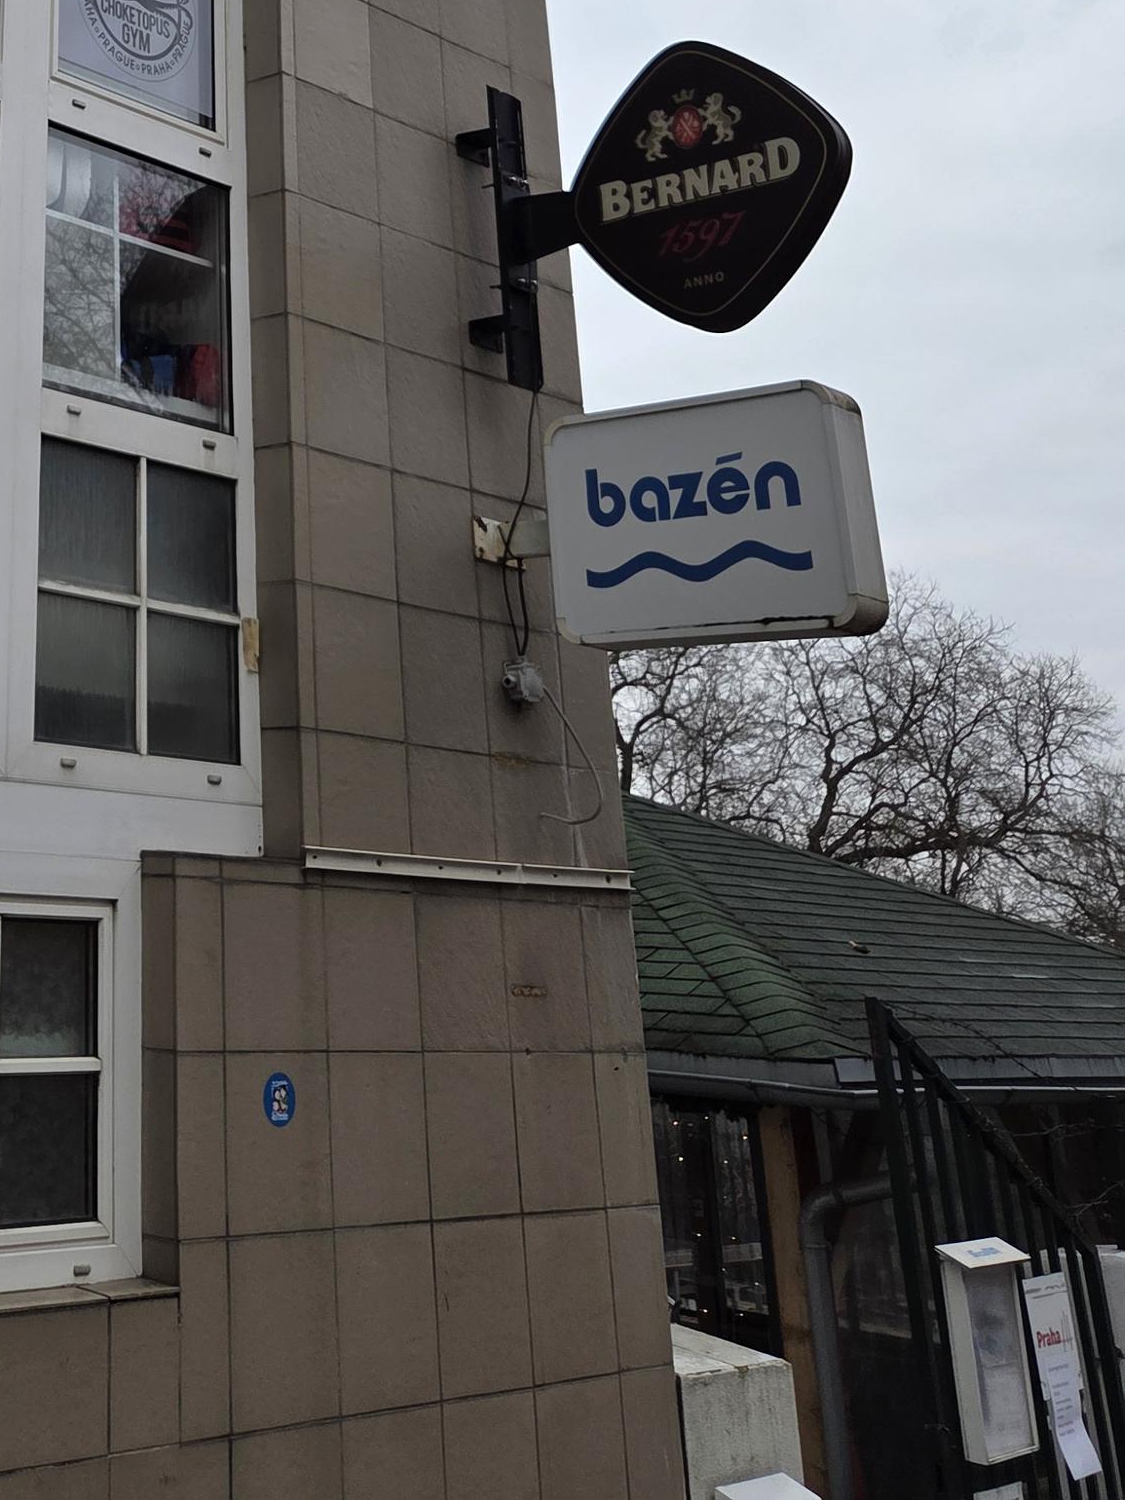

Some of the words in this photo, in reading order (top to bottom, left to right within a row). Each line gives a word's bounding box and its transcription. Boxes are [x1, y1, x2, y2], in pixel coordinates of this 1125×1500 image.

[98, 32, 136, 70] PRAGUE
[141, 63, 173, 76] PRAHA
[172, 19, 191, 64] PRAGUE
[121, 22, 151, 54] GYM
[599, 136, 801, 223] BERNARD
[658, 210, 747, 262] 1597
[683, 271, 725, 290] ANNO
[584, 451, 802, 528] bazén
[1036, 1327, 1062, 1349] Praha
